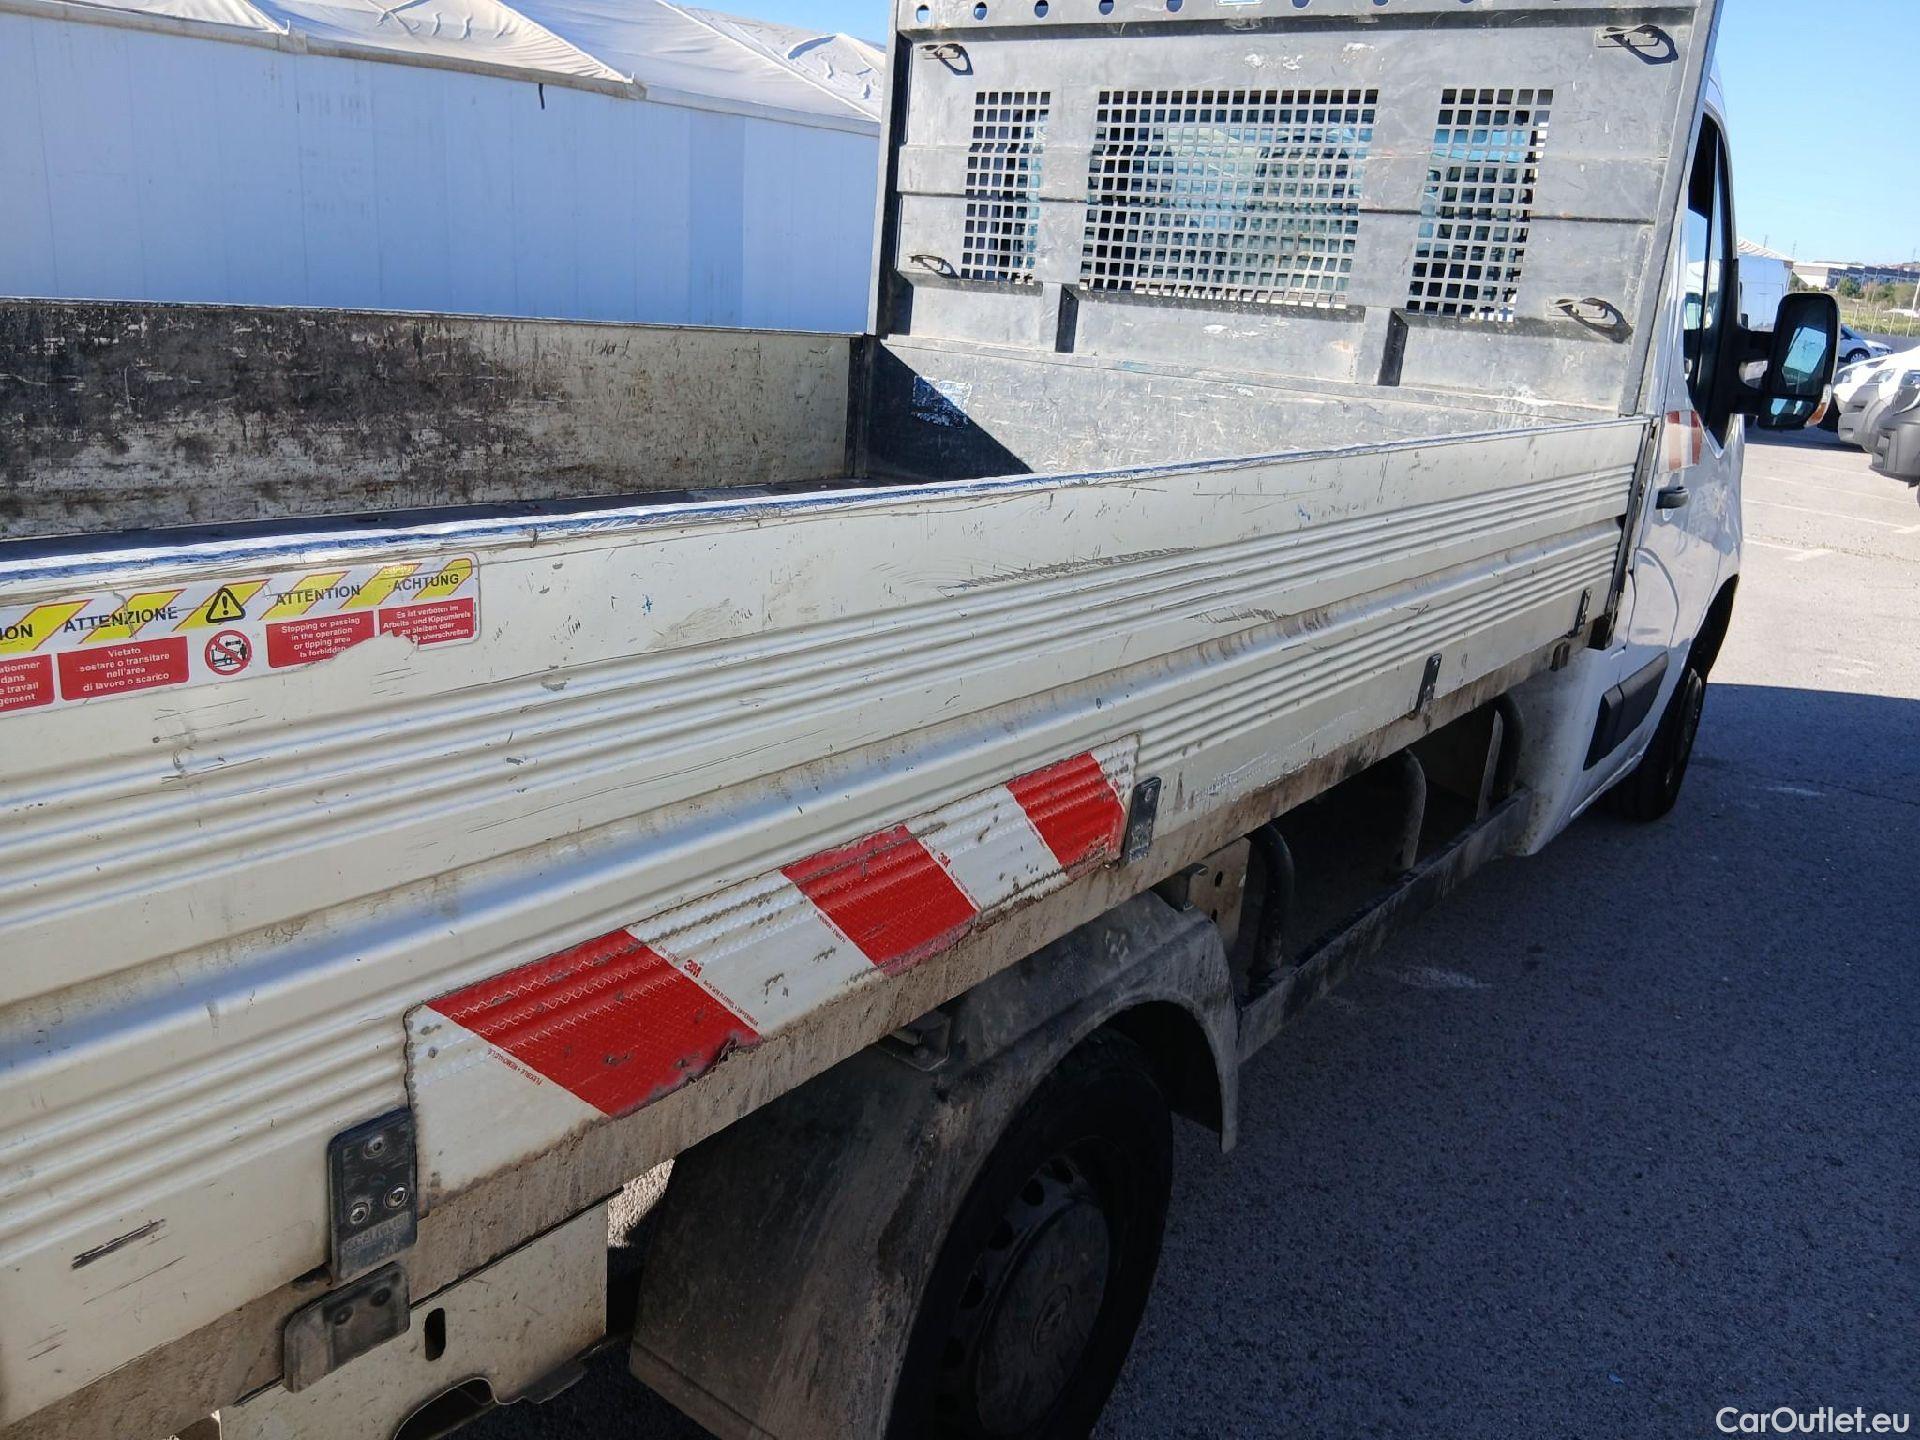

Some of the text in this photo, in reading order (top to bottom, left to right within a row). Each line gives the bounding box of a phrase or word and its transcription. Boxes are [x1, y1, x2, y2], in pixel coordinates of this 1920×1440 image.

[393, 573, 459, 591] ACHTUNG
[276, 584, 361, 606] ATTENTION
[63, 606, 179, 633] ATTENZIONE
[396, 611, 406, 619] Es
[281, 623, 318, 634] Stopping
[315, 627, 353, 638] operation
[293, 643, 303, 651] or
[305, 639, 332, 650] tipping
[108, 647, 141, 657] Vietato
[80, 661, 115, 672] sostare
[126, 653, 170, 665] transitare
[106, 667, 146, 678] nell'area
[1, 674, 26, 684] dans
[83, 682, 93, 691] di
[95, 680, 125, 690] lavoro
[135, 673, 169, 684] scarico
[7, 681, 39, 693] travail
